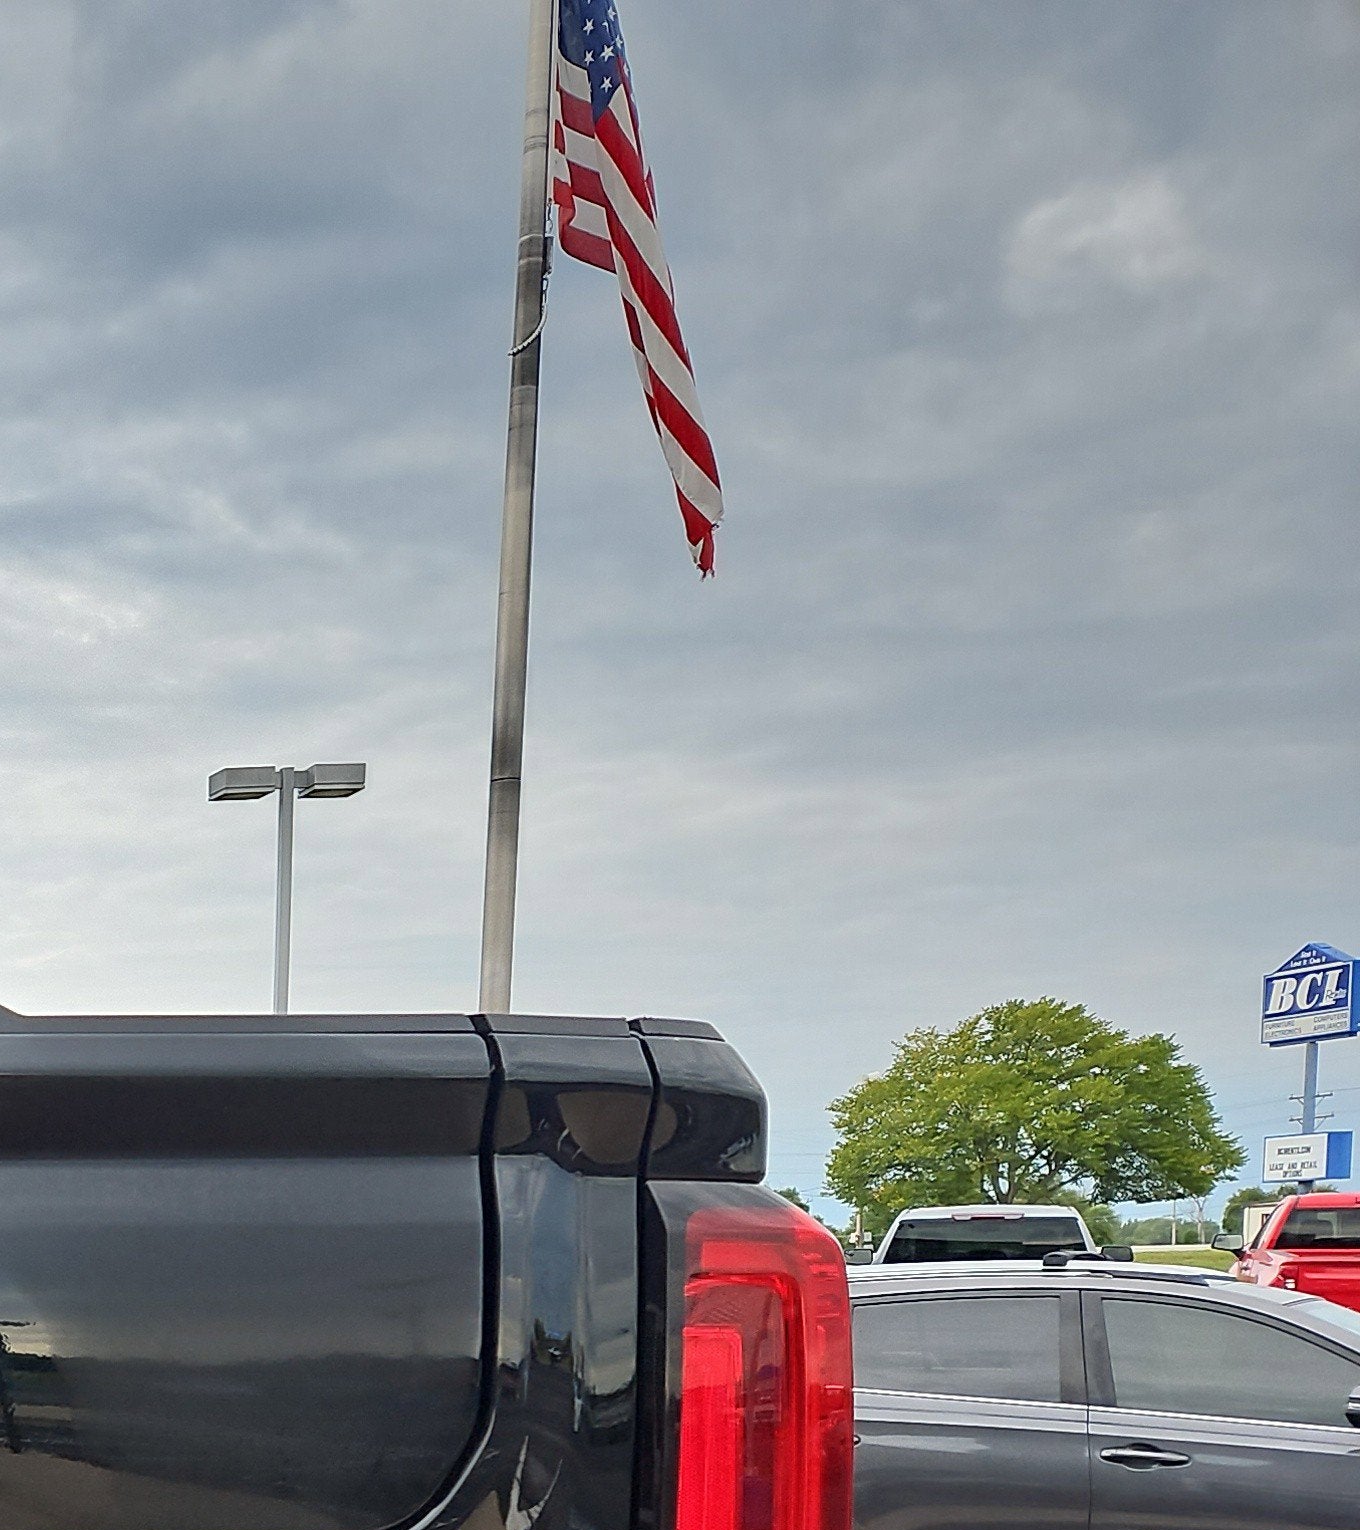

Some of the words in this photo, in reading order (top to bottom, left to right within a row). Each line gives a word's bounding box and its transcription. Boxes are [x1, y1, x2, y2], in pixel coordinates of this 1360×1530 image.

[1265, 968, 1343, 1015] BCI
[1313, 1012, 1348, 1023] COMPUTERS
[1313, 1020, 1348, 1031] APPLIANCES
[1265, 1027, 1302, 1039] ELECTRONICS
[1288, 1162, 1298, 1170] AND
[1282, 1169, 1303, 1178] OPTIONS
